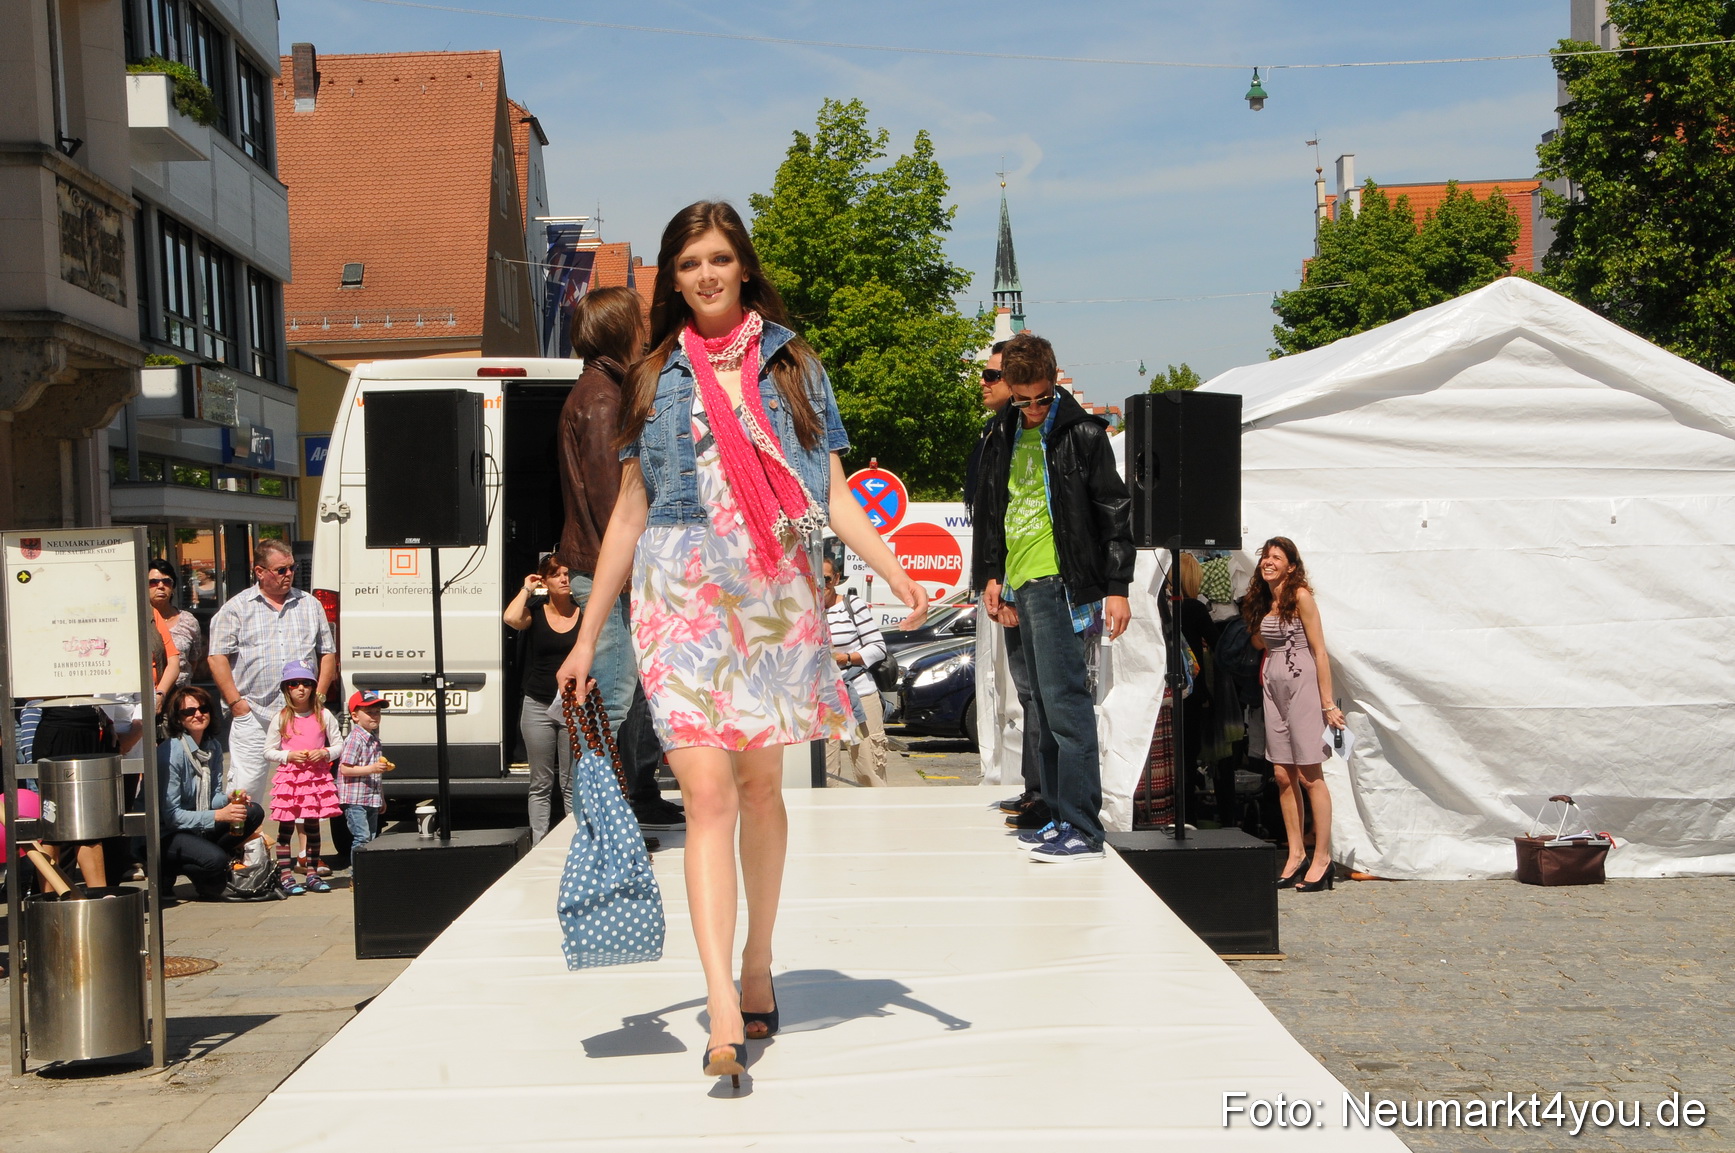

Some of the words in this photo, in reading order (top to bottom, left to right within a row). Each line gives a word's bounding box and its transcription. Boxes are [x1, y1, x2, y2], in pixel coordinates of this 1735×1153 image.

[47, 539, 95, 549] NEUMARKT
[355, 586, 379, 596] petri
[352, 650, 426, 659] PEUGEOT
[53, 661, 106, 669] BAHNHOFSTRASSE
